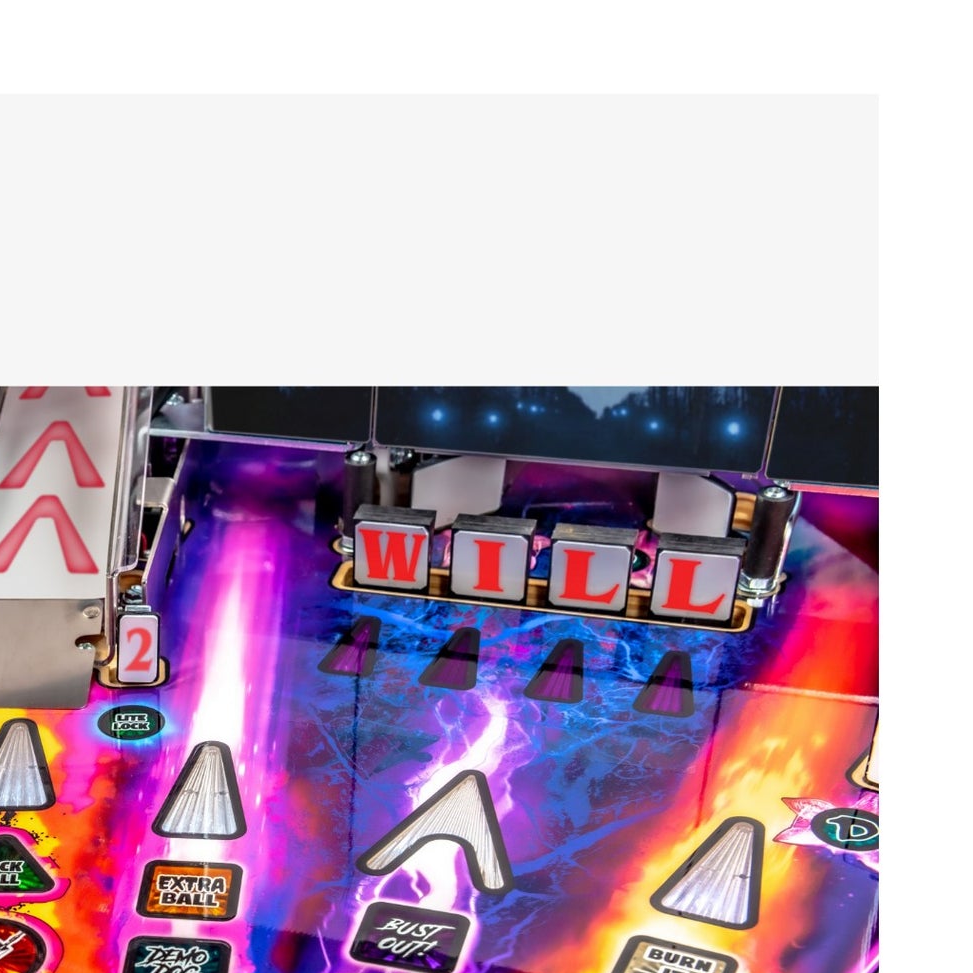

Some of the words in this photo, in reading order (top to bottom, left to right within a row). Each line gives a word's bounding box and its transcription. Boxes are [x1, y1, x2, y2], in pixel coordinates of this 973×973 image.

[124, 627, 153, 672] 2
[112, 722, 149, 731] LOCK
[115, 713, 148, 723] LITE
[158, 875, 226, 892] EXTRA
[160, 892, 219, 907] BALL
[376, 918, 456, 941] BUST
[135, 946, 208, 967] DEMO
[377, 937, 438, 958] OUT!
[646, 947, 714, 973] BURN
